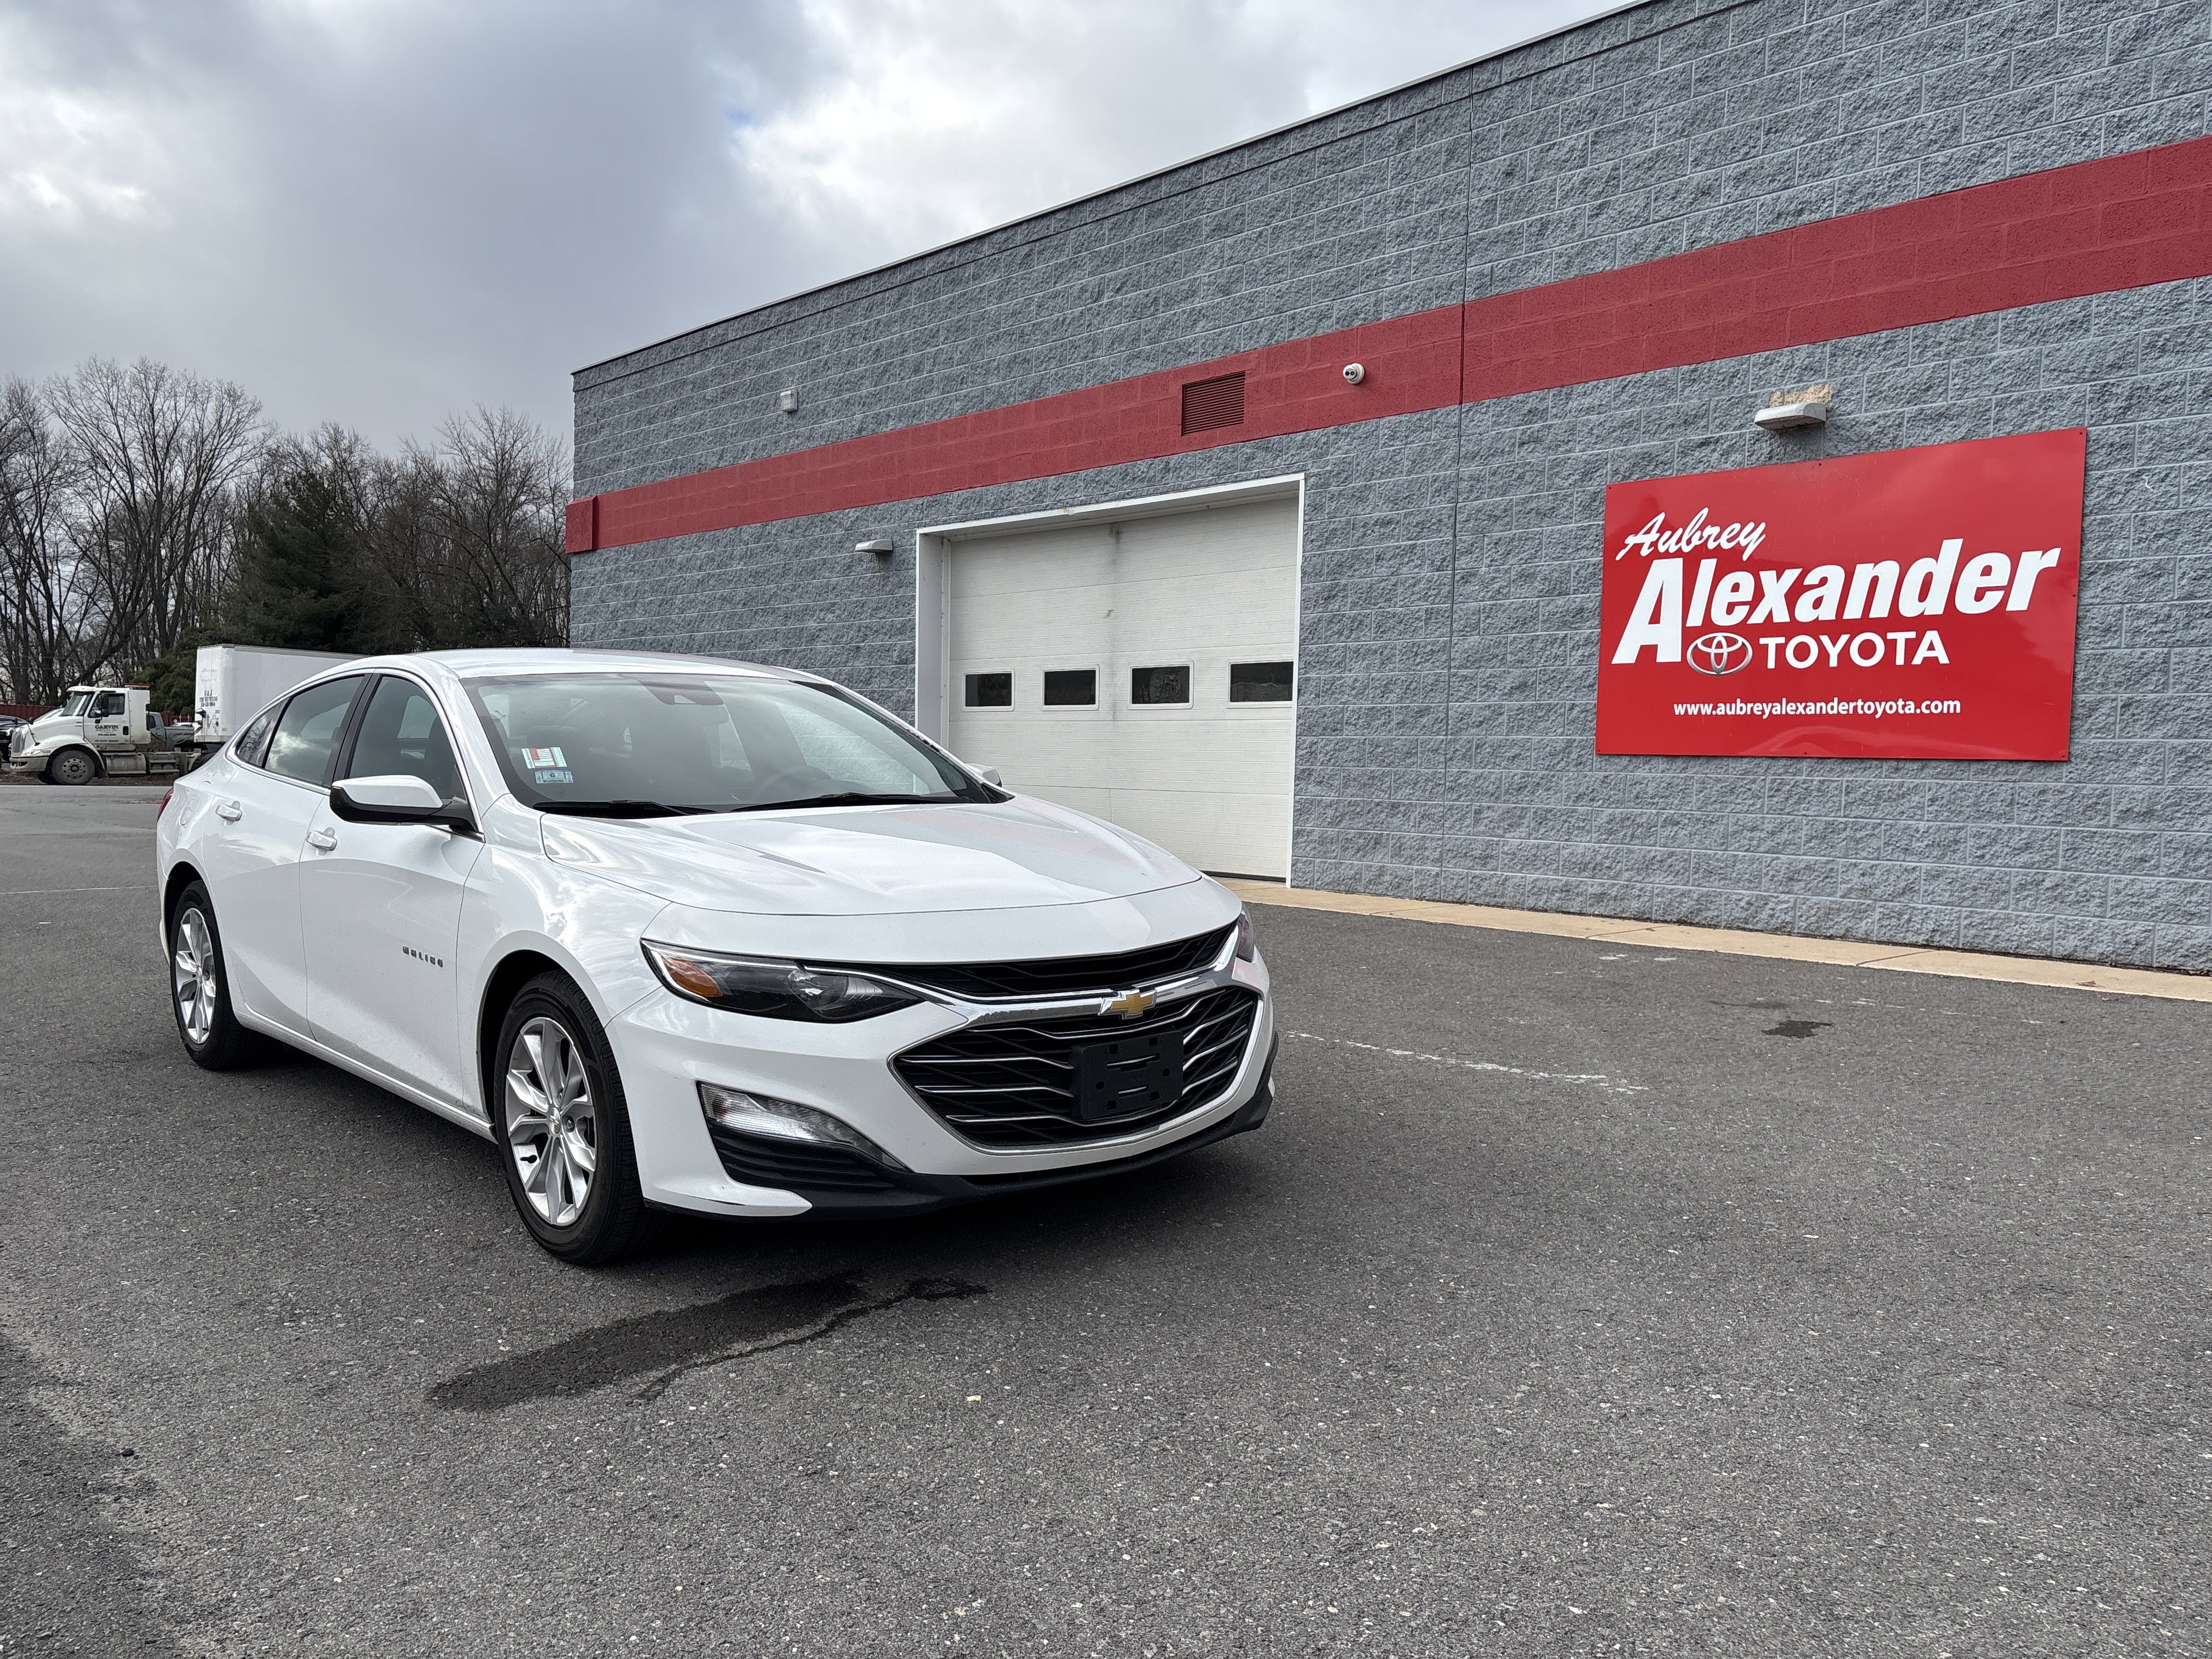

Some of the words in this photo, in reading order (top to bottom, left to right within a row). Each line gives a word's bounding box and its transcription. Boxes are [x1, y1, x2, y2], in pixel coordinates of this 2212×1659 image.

[1615, 507, 1766, 561] Aubrey
[1611, 538, 2062, 664] Alexander
[1759, 630, 1950, 669] TOYOTA
[1673, 697, 1961, 720] www.aubreyalexandertoyota.com
